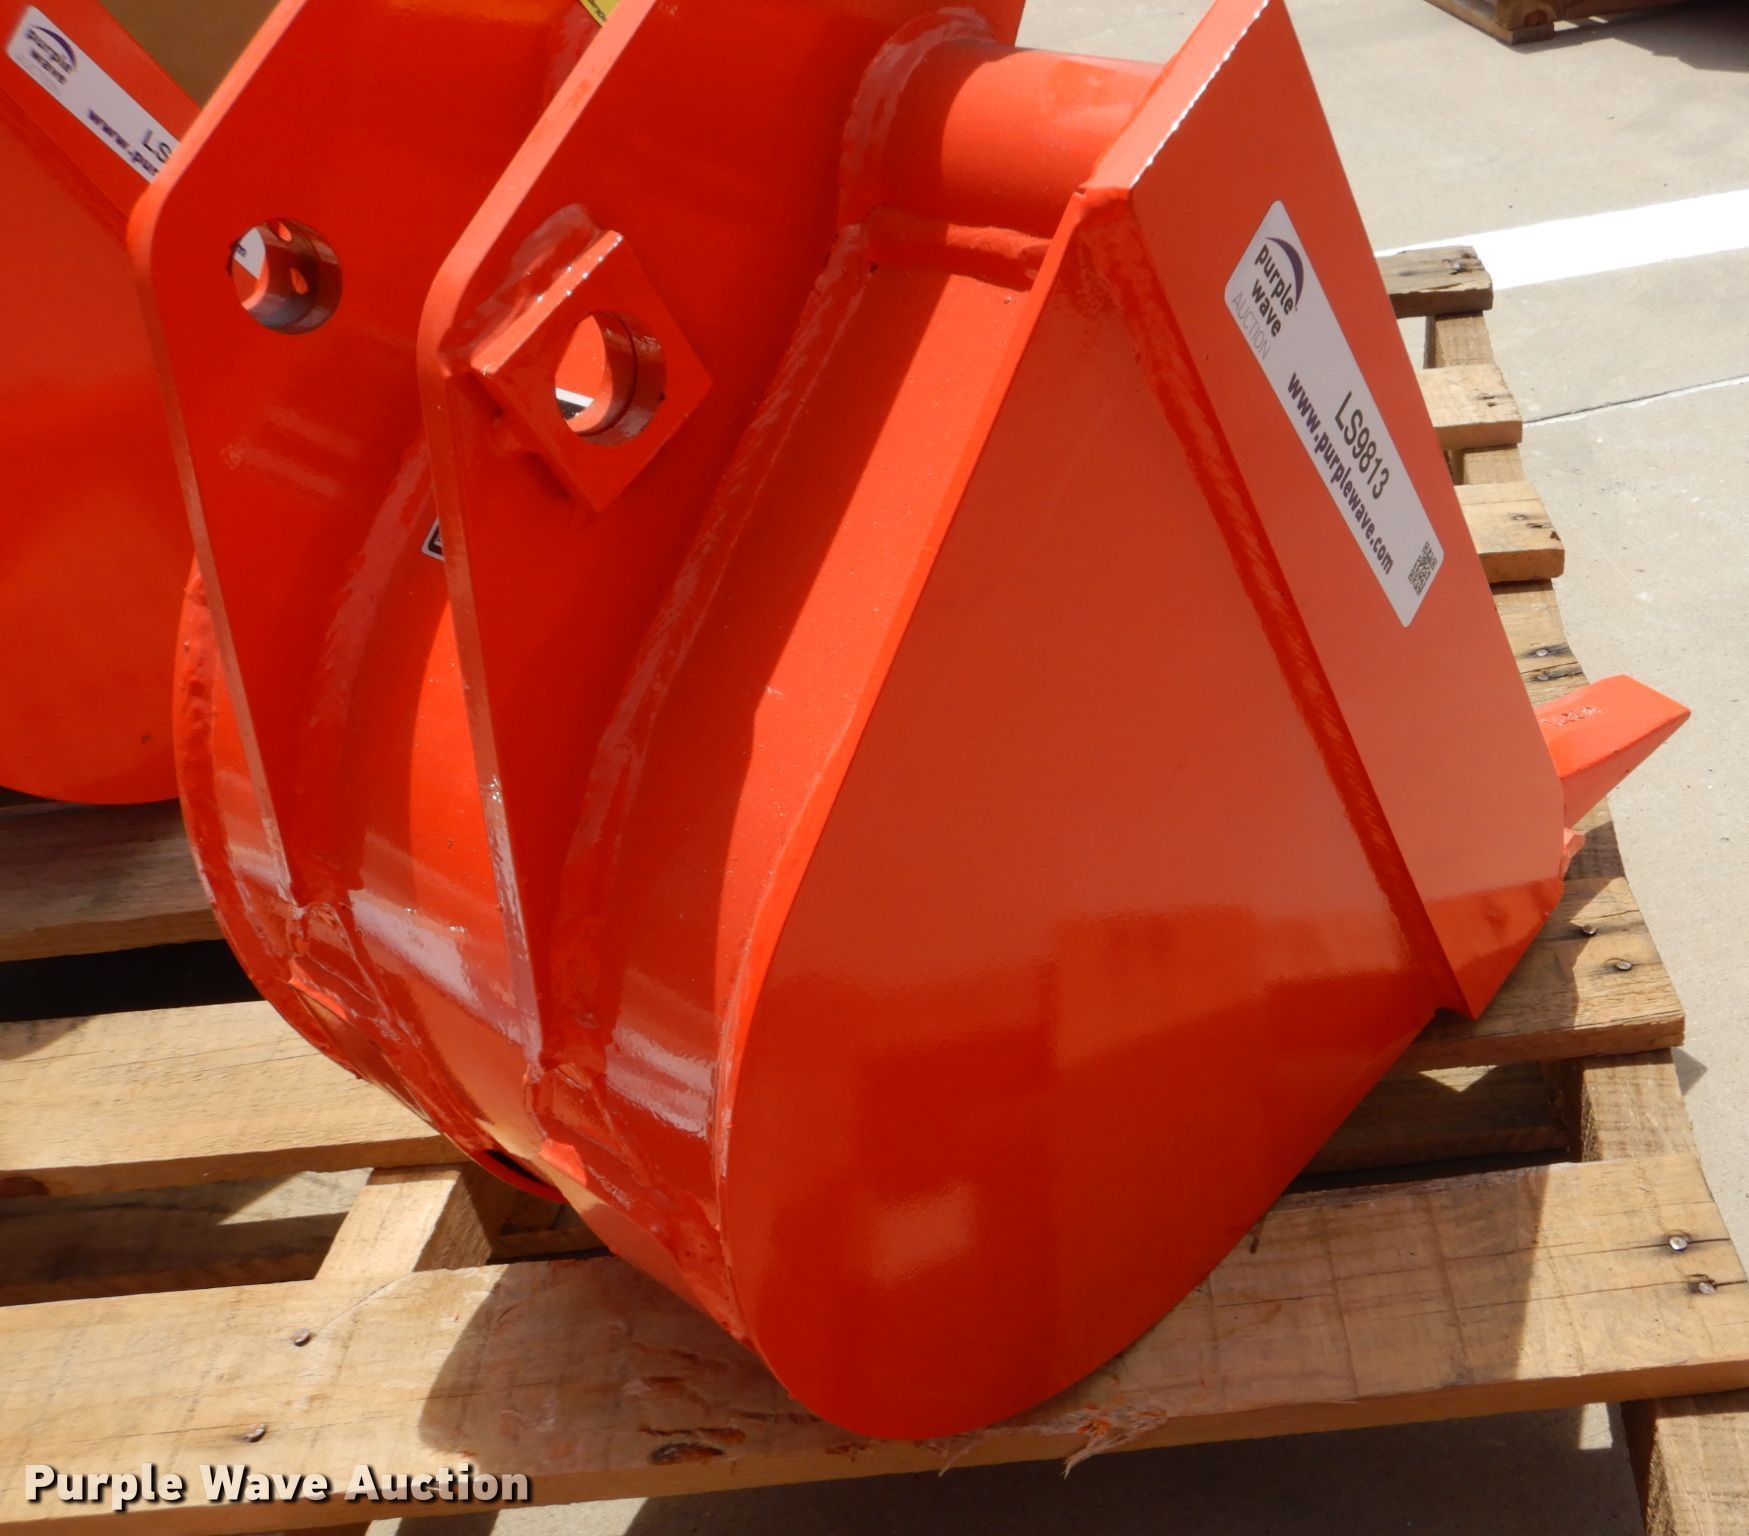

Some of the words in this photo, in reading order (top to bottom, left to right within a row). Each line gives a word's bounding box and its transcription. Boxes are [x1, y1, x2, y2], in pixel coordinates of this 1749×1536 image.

[1252, 279, 1281, 337] wave
[1254, 244, 1294, 315] purple
[1232, 293, 1270, 360] AUCTION
[1287, 373, 1394, 575] www.purplewave.com
[1334, 391, 1390, 500] LS9813
